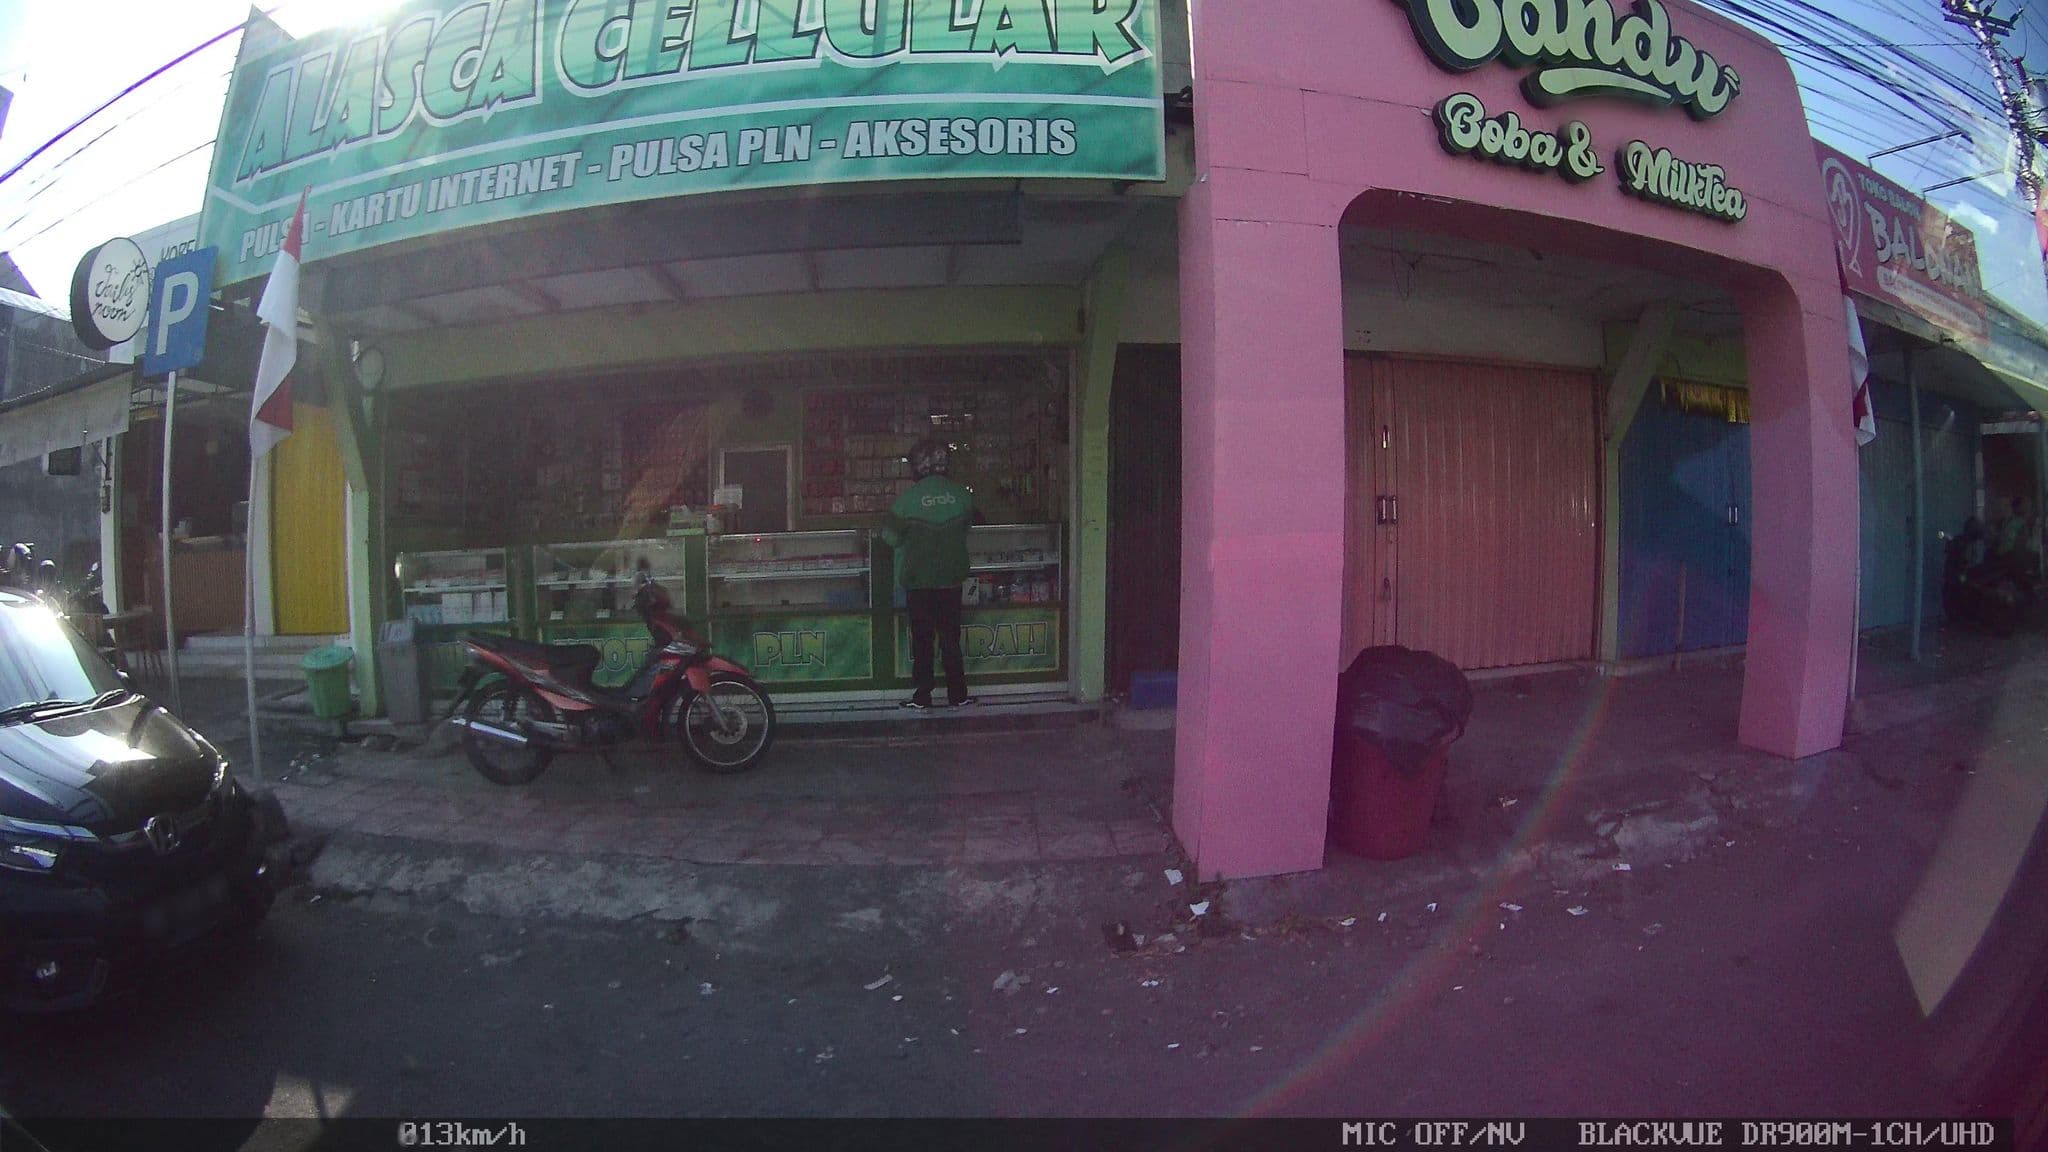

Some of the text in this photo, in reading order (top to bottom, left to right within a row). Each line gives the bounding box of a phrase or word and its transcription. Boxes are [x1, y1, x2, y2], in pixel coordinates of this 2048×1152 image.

[234, 0, 543, 186] ALASCA
[328, 181, 424, 238] KARTU
[425, 151, 582, 213] INTERNET
[607, 132, 730, 182] PULSA
[736, 124, 812, 166] PLN
[842, 117, 1076, 160] AKSESORIS
[1444, 94, 1563, 167] Boba
[1567, 120, 1604, 178] &
[156, 271, 199, 355] P
[921, 493, 956, 507] Grab
[754, 631, 827, 666] PLN
